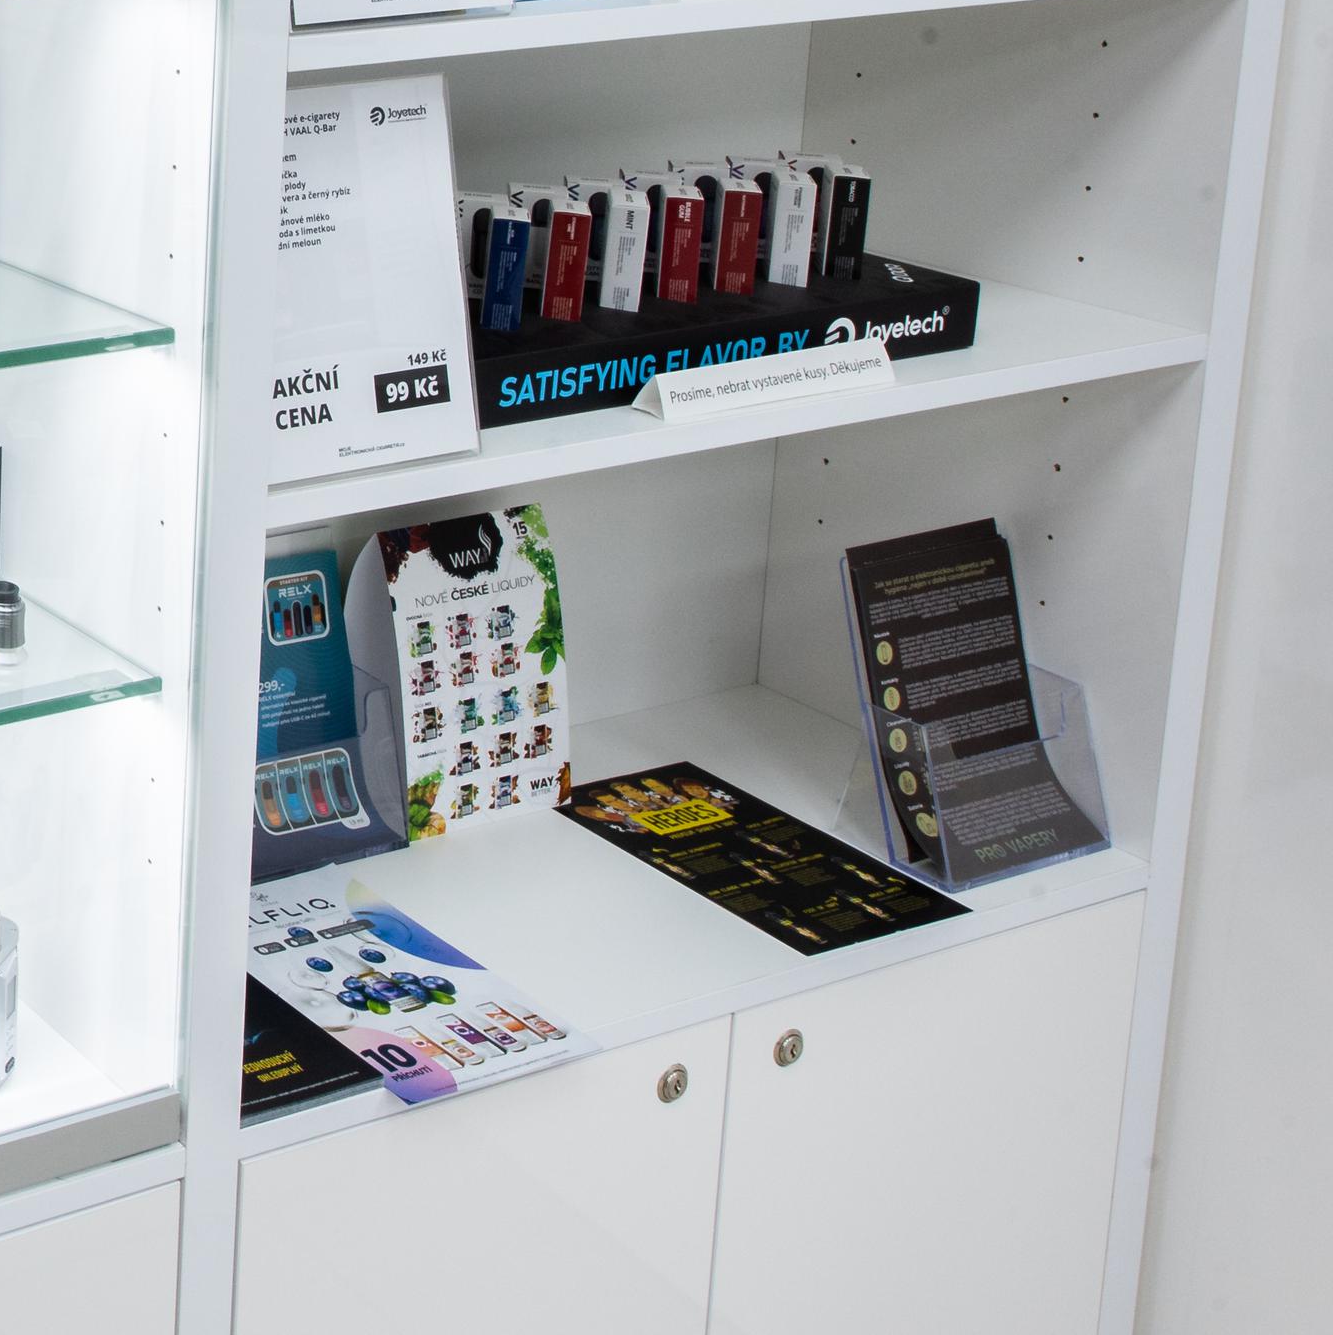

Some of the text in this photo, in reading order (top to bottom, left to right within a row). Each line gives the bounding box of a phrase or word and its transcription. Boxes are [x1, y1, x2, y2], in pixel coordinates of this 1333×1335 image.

[388, 105, 426, 120] Joyetech
[407, 349, 446, 366] 149 Kč
[272, 366, 339, 399] AKČNÍ
[386, 377, 438, 403] 99 Kč
[498, 353, 657, 408] SATISFYING
[669, 356, 882, 403] Prosíme, nebrat vystavené kusy. Děkujeme
[275, 403, 332, 430] CENA
[450, 549, 482, 569] WAY
[415, 575, 535, 609] NOVÉ ČESKÉ LIQUIDY
[648, 803, 721, 831] HEROES
[361, 1043, 418, 1073] 10
